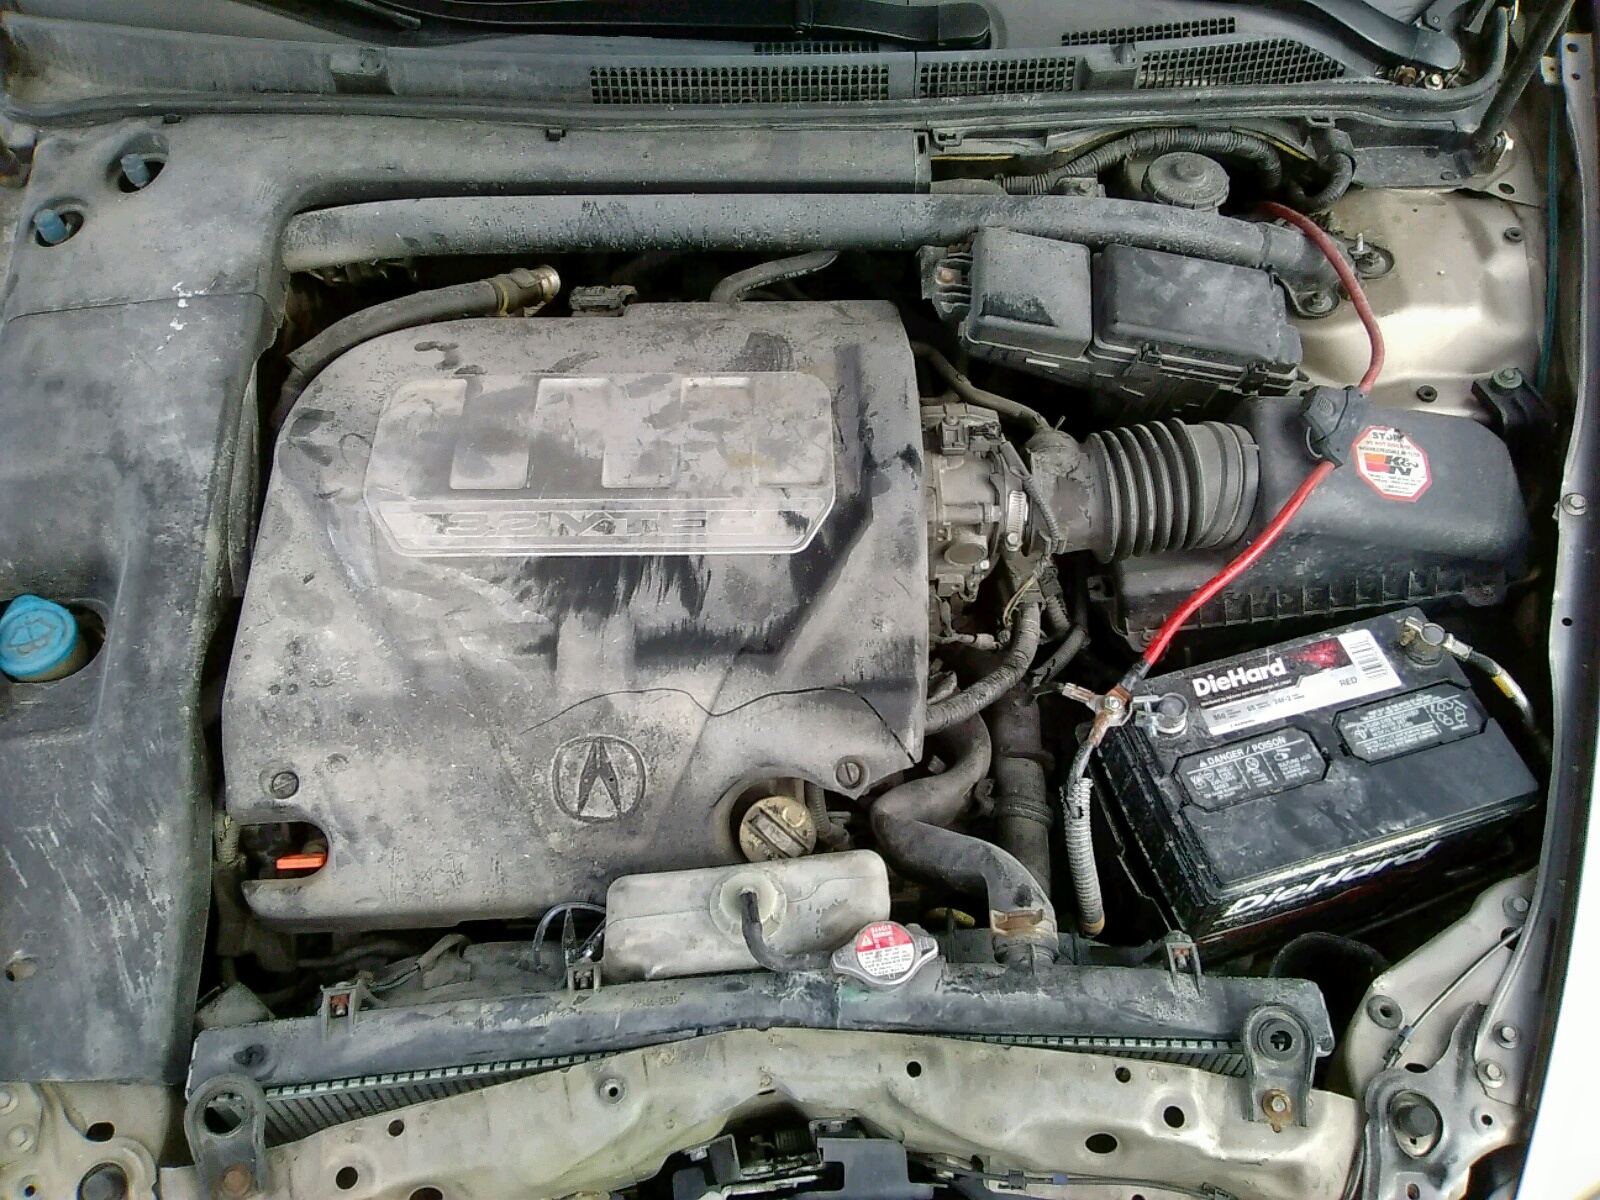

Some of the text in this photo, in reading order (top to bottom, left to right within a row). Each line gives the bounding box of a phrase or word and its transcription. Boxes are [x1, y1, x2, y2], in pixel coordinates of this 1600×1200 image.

[1192, 657, 1288, 697] DieHard
[1339, 676, 1358, 687] RED
[1207, 748, 1244, 765] DANGER
[1252, 736, 1287, 751] POISON
[1222, 840, 1441, 917] DieHard
